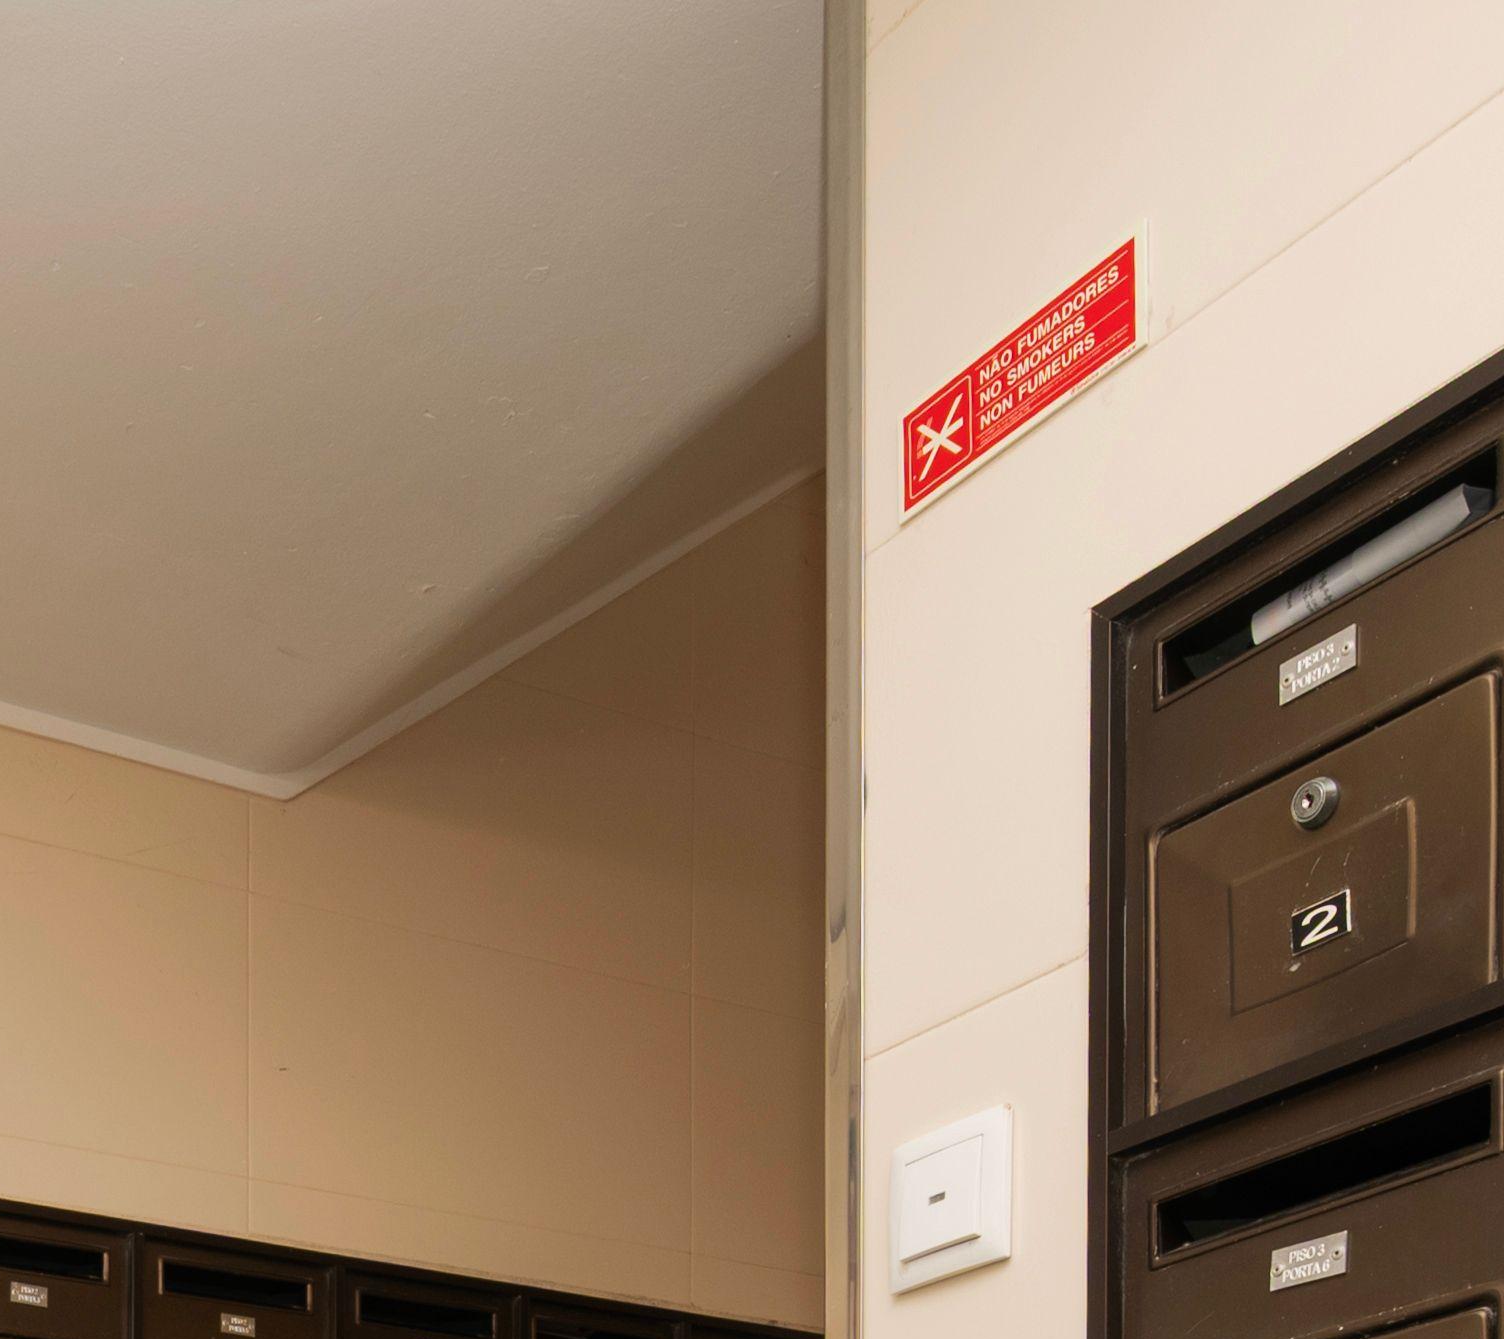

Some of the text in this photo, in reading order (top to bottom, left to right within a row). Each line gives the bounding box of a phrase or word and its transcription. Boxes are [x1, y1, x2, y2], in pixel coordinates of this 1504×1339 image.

[978, 347, 1013, 387] NÃO
[1016, 263, 1120, 357] FUMADORES
[979, 380, 1003, 407] NO
[1007, 314, 1087, 388] SMOKERS
[979, 397, 1014, 431] NON
[1018, 333, 1097, 404] FUMEURS
[1291, 663, 1332, 693] PORTA
[1297, 648, 1325, 673] PISO
[1301, 904, 1338, 947] 2
[1281, 1259, 1330, 1283] PORTA 6
[1288, 1243, 1326, 1264] PISO 3
